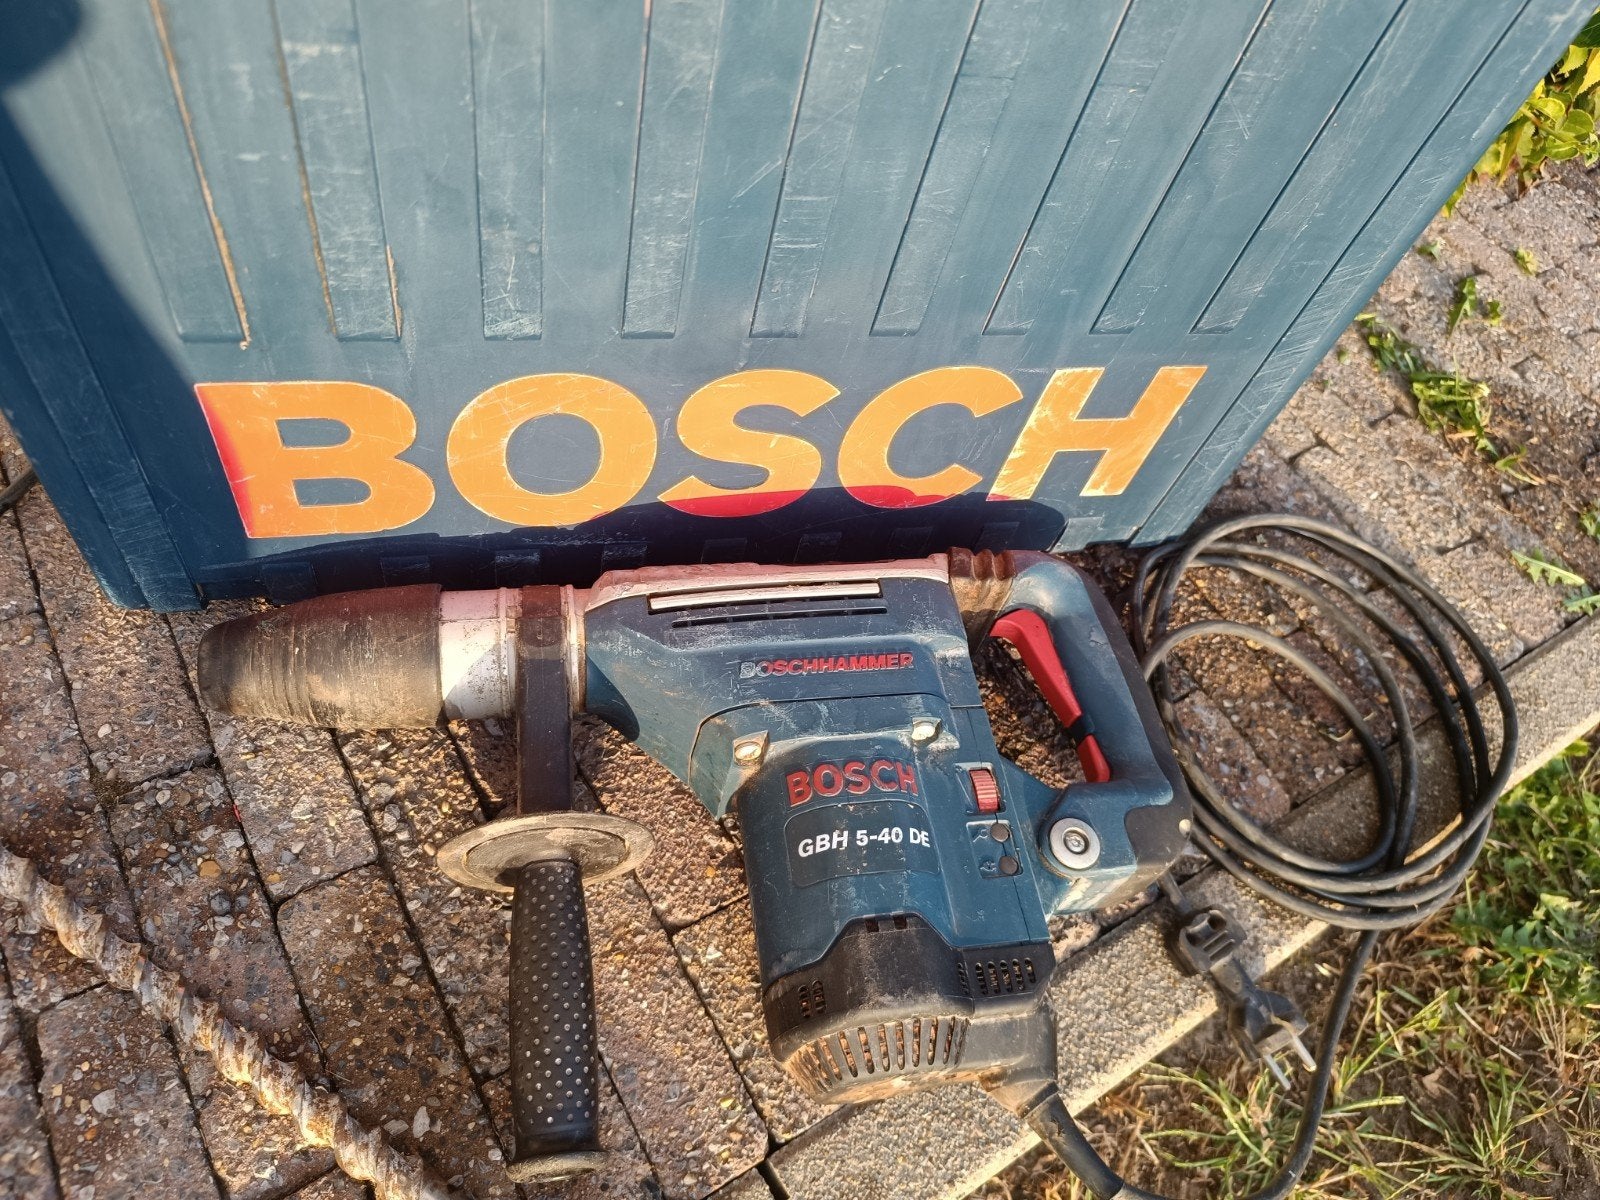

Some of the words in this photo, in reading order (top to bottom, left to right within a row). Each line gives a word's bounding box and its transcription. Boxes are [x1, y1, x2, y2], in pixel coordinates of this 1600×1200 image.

[194, 365, 1208, 539] BOSCH
[739, 652, 914, 679] BOSCHHAMMER
[786, 759, 919, 807] BOSCH
[798, 829, 849, 858] GBH
[855, 826, 903, 847] 5-40
[909, 827, 931, 848] DE
